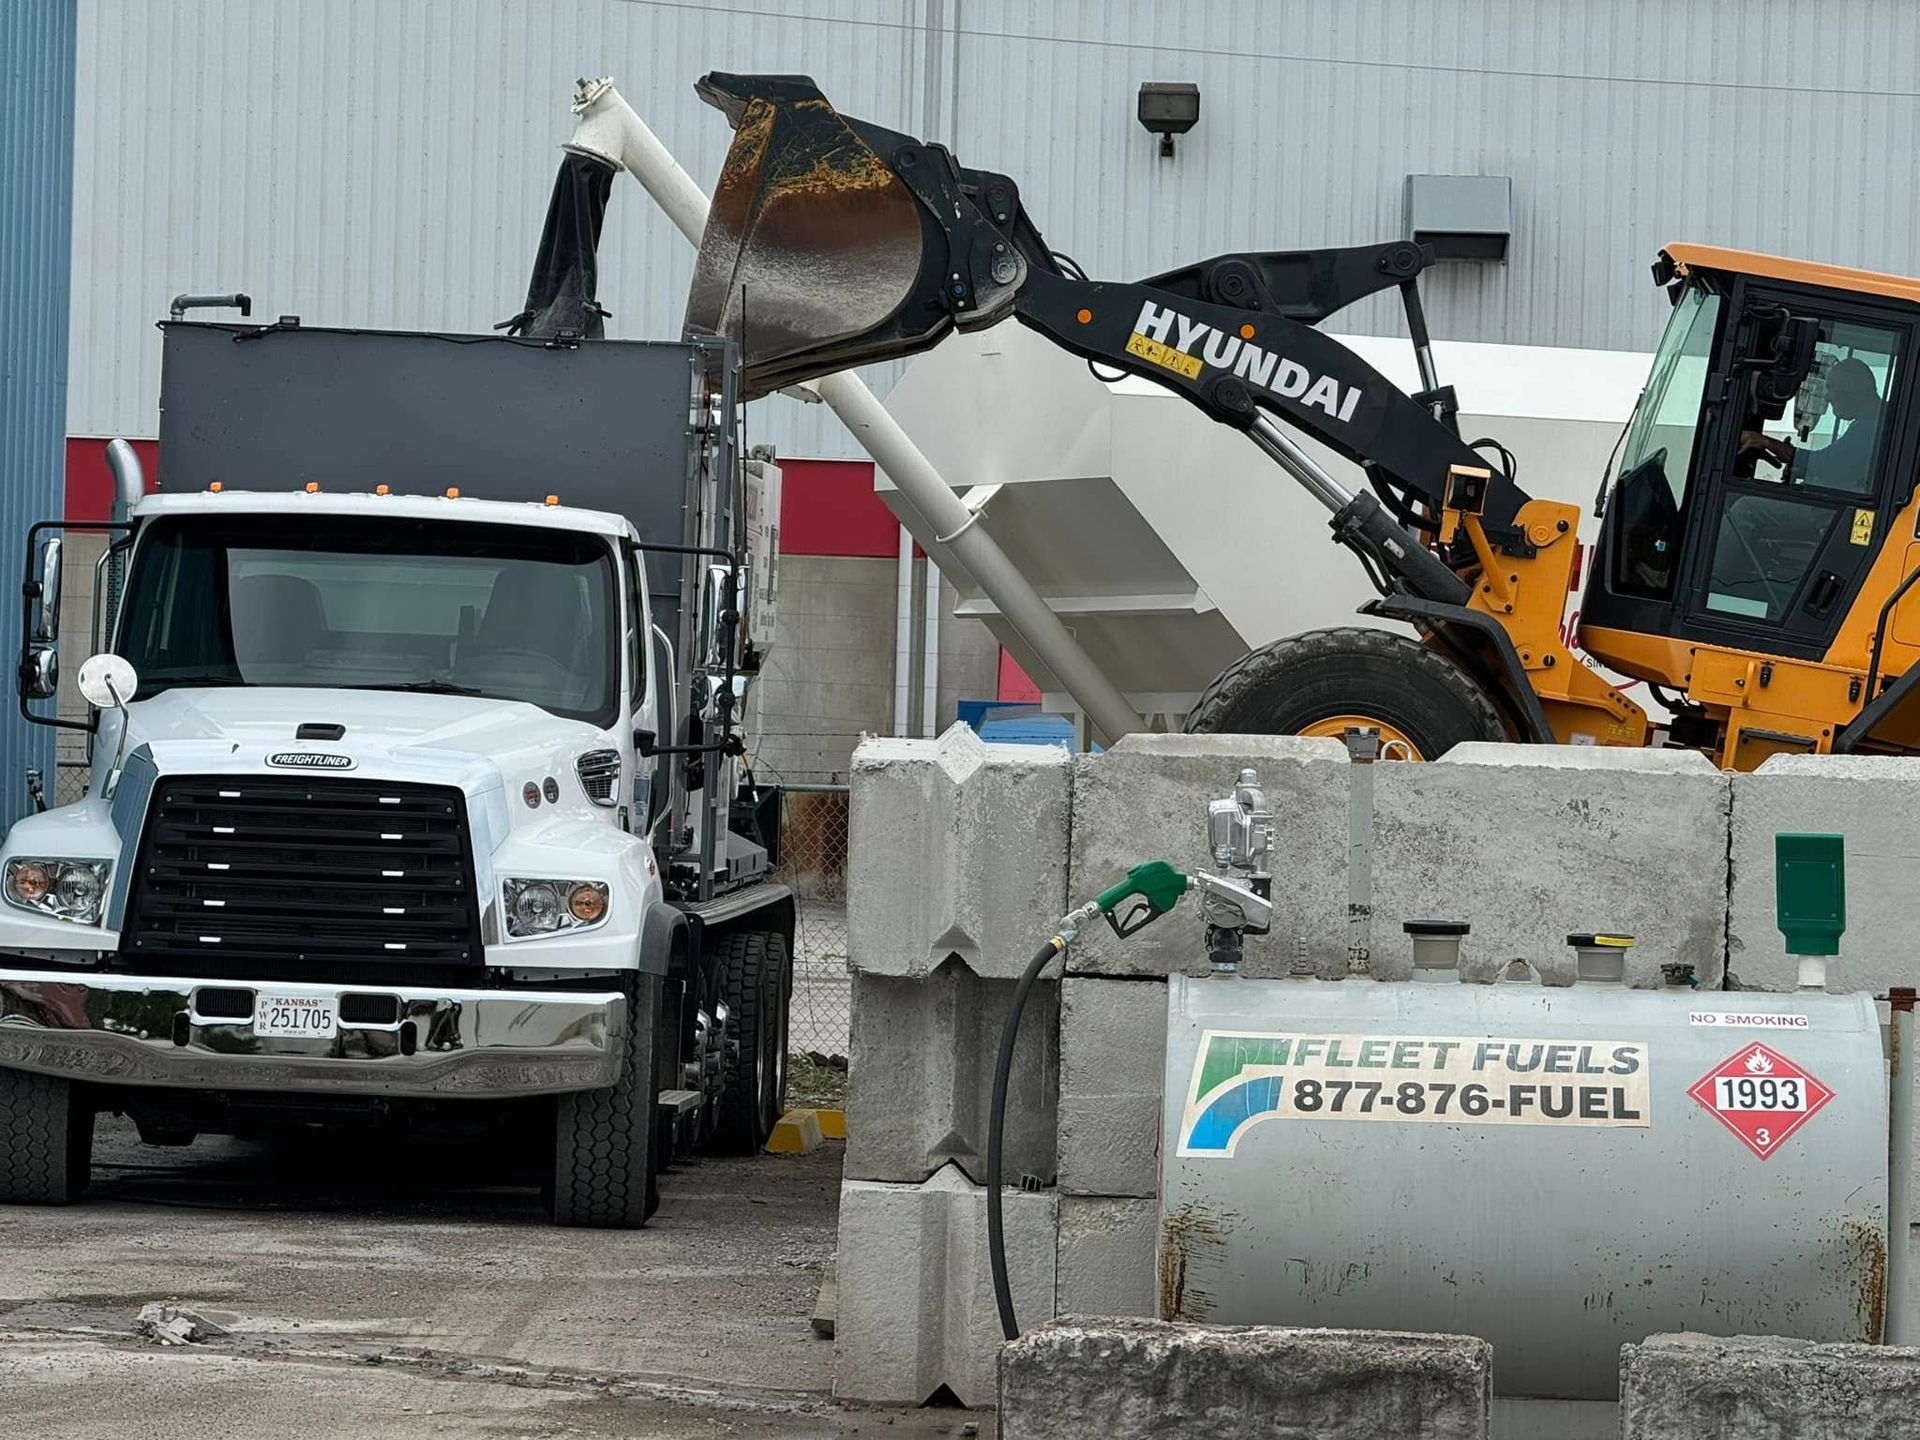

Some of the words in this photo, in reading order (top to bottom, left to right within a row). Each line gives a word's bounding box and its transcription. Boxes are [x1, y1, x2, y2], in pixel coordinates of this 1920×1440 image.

[1133, 300, 1362, 423] HYUNDAI
[274, 754, 349, 767] FREIGHTLINER
[275, 998, 319, 1007] KANSAS
[270, 1007, 331, 1029] 251705
[1690, 1014, 1717, 1024] NO
[1724, 1015, 1808, 1027] SMOKING
[1293, 1039, 1461, 1070] FLEET
[1472, 1043, 1640, 1075] FUELS
[1293, 1079, 1640, 1120] 877-876-FUEL
[1722, 1079, 1799, 1109] 1993
[1755, 1128, 1771, 1146] 3
